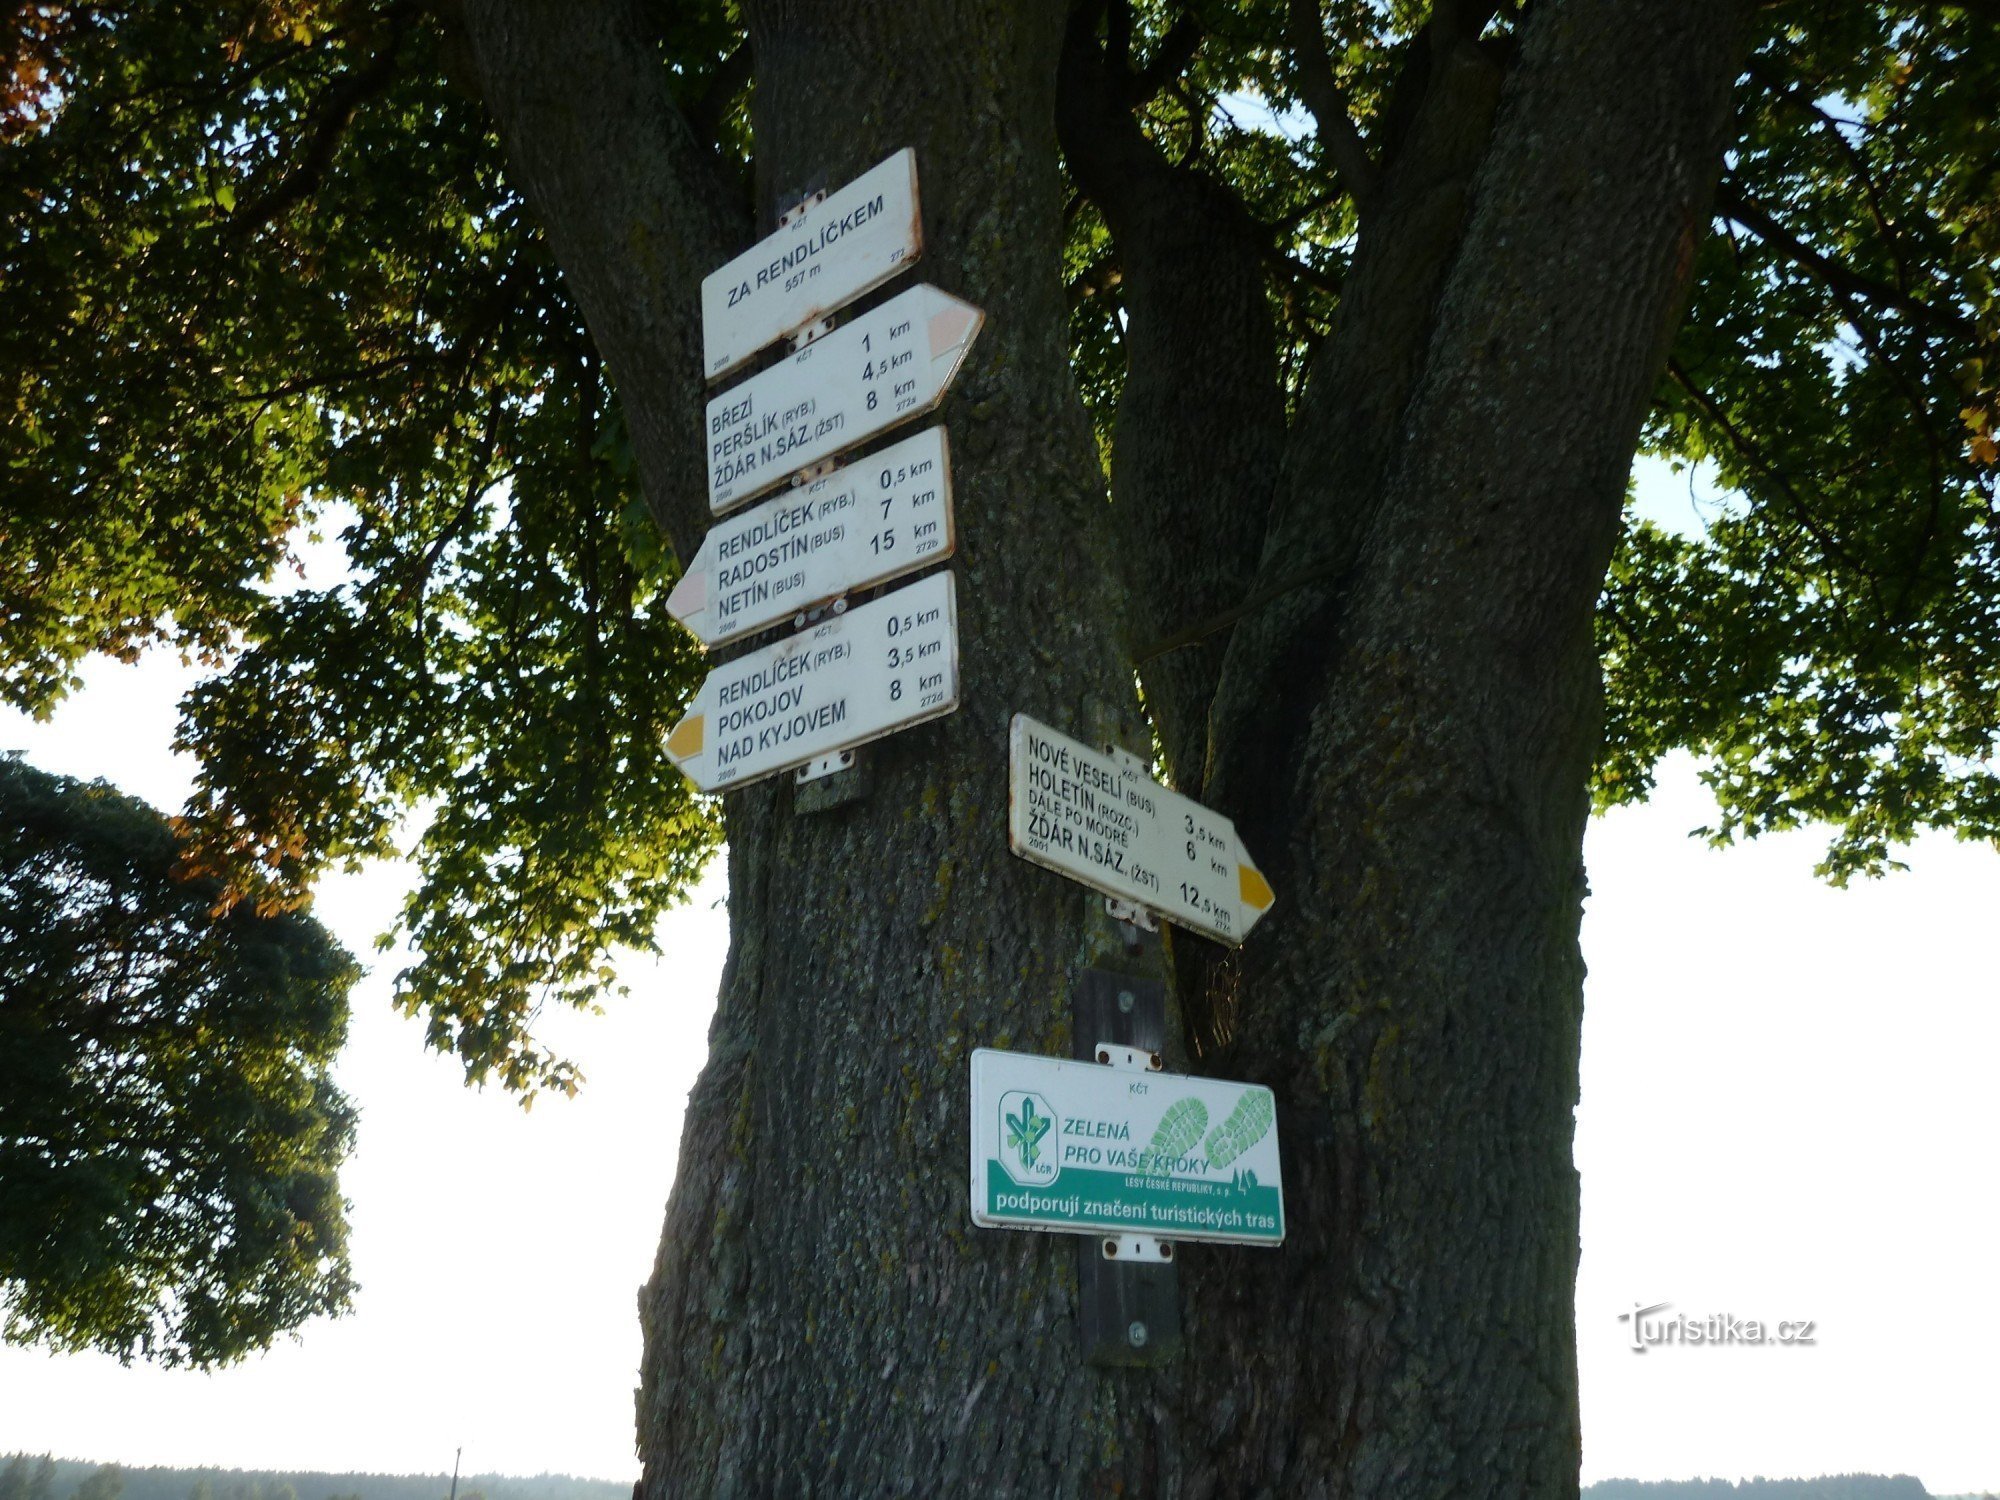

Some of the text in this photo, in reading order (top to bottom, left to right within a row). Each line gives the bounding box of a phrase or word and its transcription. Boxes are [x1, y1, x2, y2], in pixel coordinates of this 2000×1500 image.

[727, 195, 884, 308] ZA RENDLÍČKEM
[785, 264, 821, 293] 557 m
[712, 320, 911, 435] BŘEZÍ 1 km
[713, 350, 912, 461] PERŠLÍK (RYB.) 4,5 km
[714, 452, 756, 489] ŽĎÁR
[815, 413, 845, 440] (ŽST)
[867, 391, 878, 411] 8
[894, 378, 916, 397] km
[718, 459, 933, 562] RENDLÍČEK (RYB.) 0,5 km
[718, 490, 935, 591] RADOSTÍN (BUS) 7 km
[718, 520, 937, 620] NETÍN (BUS) 15 km
[719, 607, 940, 707] RENDLÍČEK (RYB.) 0,5 km
[719, 639, 941, 737] POKOJOV 3,5 km
[718, 672, 942, 767] NAD KYJOVEM 8 km
[1029, 735, 1226, 851] NOVÉ VESELÍ (BUS) 3,5 km
[1029, 789, 1129, 848] DÁLE PO MODRÉ
[1029, 762, 1094, 813] HOLETÍN
[1186, 841, 1196, 861] 6
[1210, 858, 1227, 877] km
[1029, 837, 1049, 853] 2001
[1029, 809, 1073, 851] ŽĎÁR
[1131, 864, 1160, 893] (ŽST)
[1179, 882, 1211, 914] 12,5
[1213, 901, 1231, 922] km
[1063, 1118, 1130, 1142] ZELENÁ
[1129, 1082, 1149, 1096] KČT
[996, 1191, 1275, 1231] podporují značení turistických tras
[1064, 1147, 1211, 1176] PRO VAŠE KROKY
[1125, 1176, 1144, 1190] LESY
[1145, 1176, 1171, 1192] ČESKÉ
